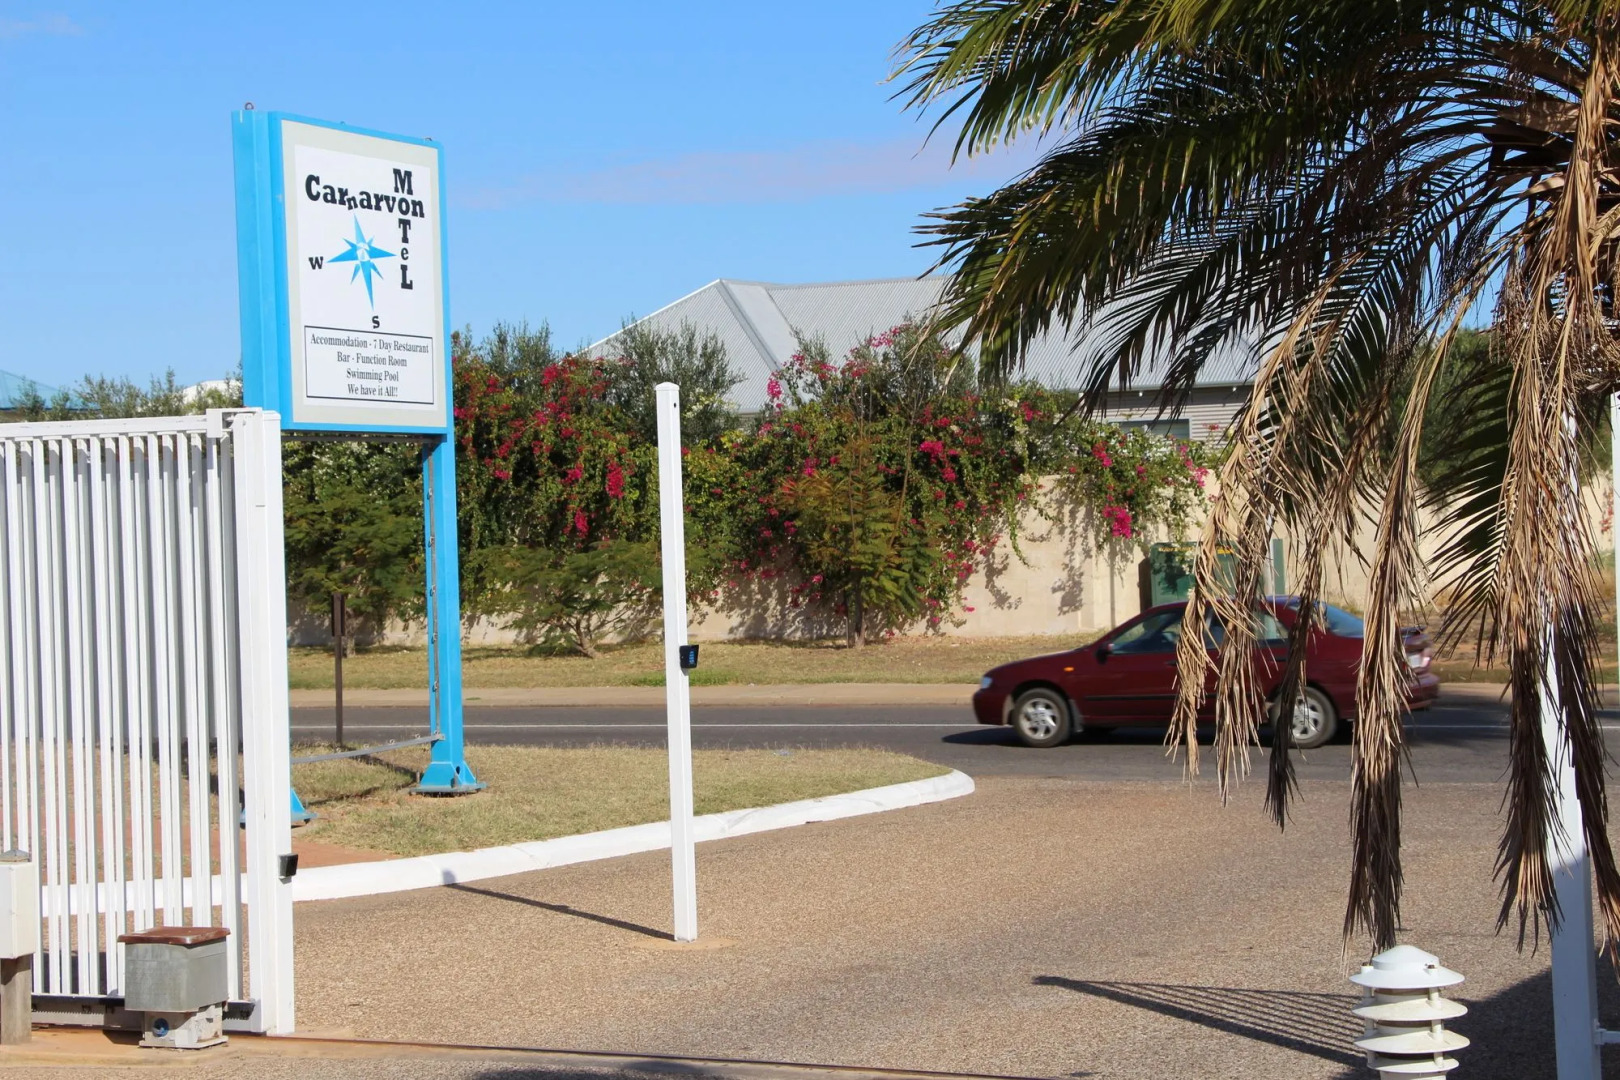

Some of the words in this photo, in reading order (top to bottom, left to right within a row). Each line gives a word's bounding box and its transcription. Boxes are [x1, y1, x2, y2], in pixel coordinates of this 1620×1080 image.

[305, 174, 425, 218] Carnarvon
[310, 333, 368, 348] Accommodation
[373, 339, 377, 349] 7
[378, 339, 392, 352] Day
[393, 340, 429, 353] Restaurant
[337, 351, 350, 362] Bar
[356, 353, 387, 365] Function
[388, 355, 407, 367] Room
[346, 368, 382, 383] Swimming
[384, 371, 399, 381] Pool
[347, 384, 359, 395] We
[360, 385, 376, 396] have
[378, 387, 383, 396] it
